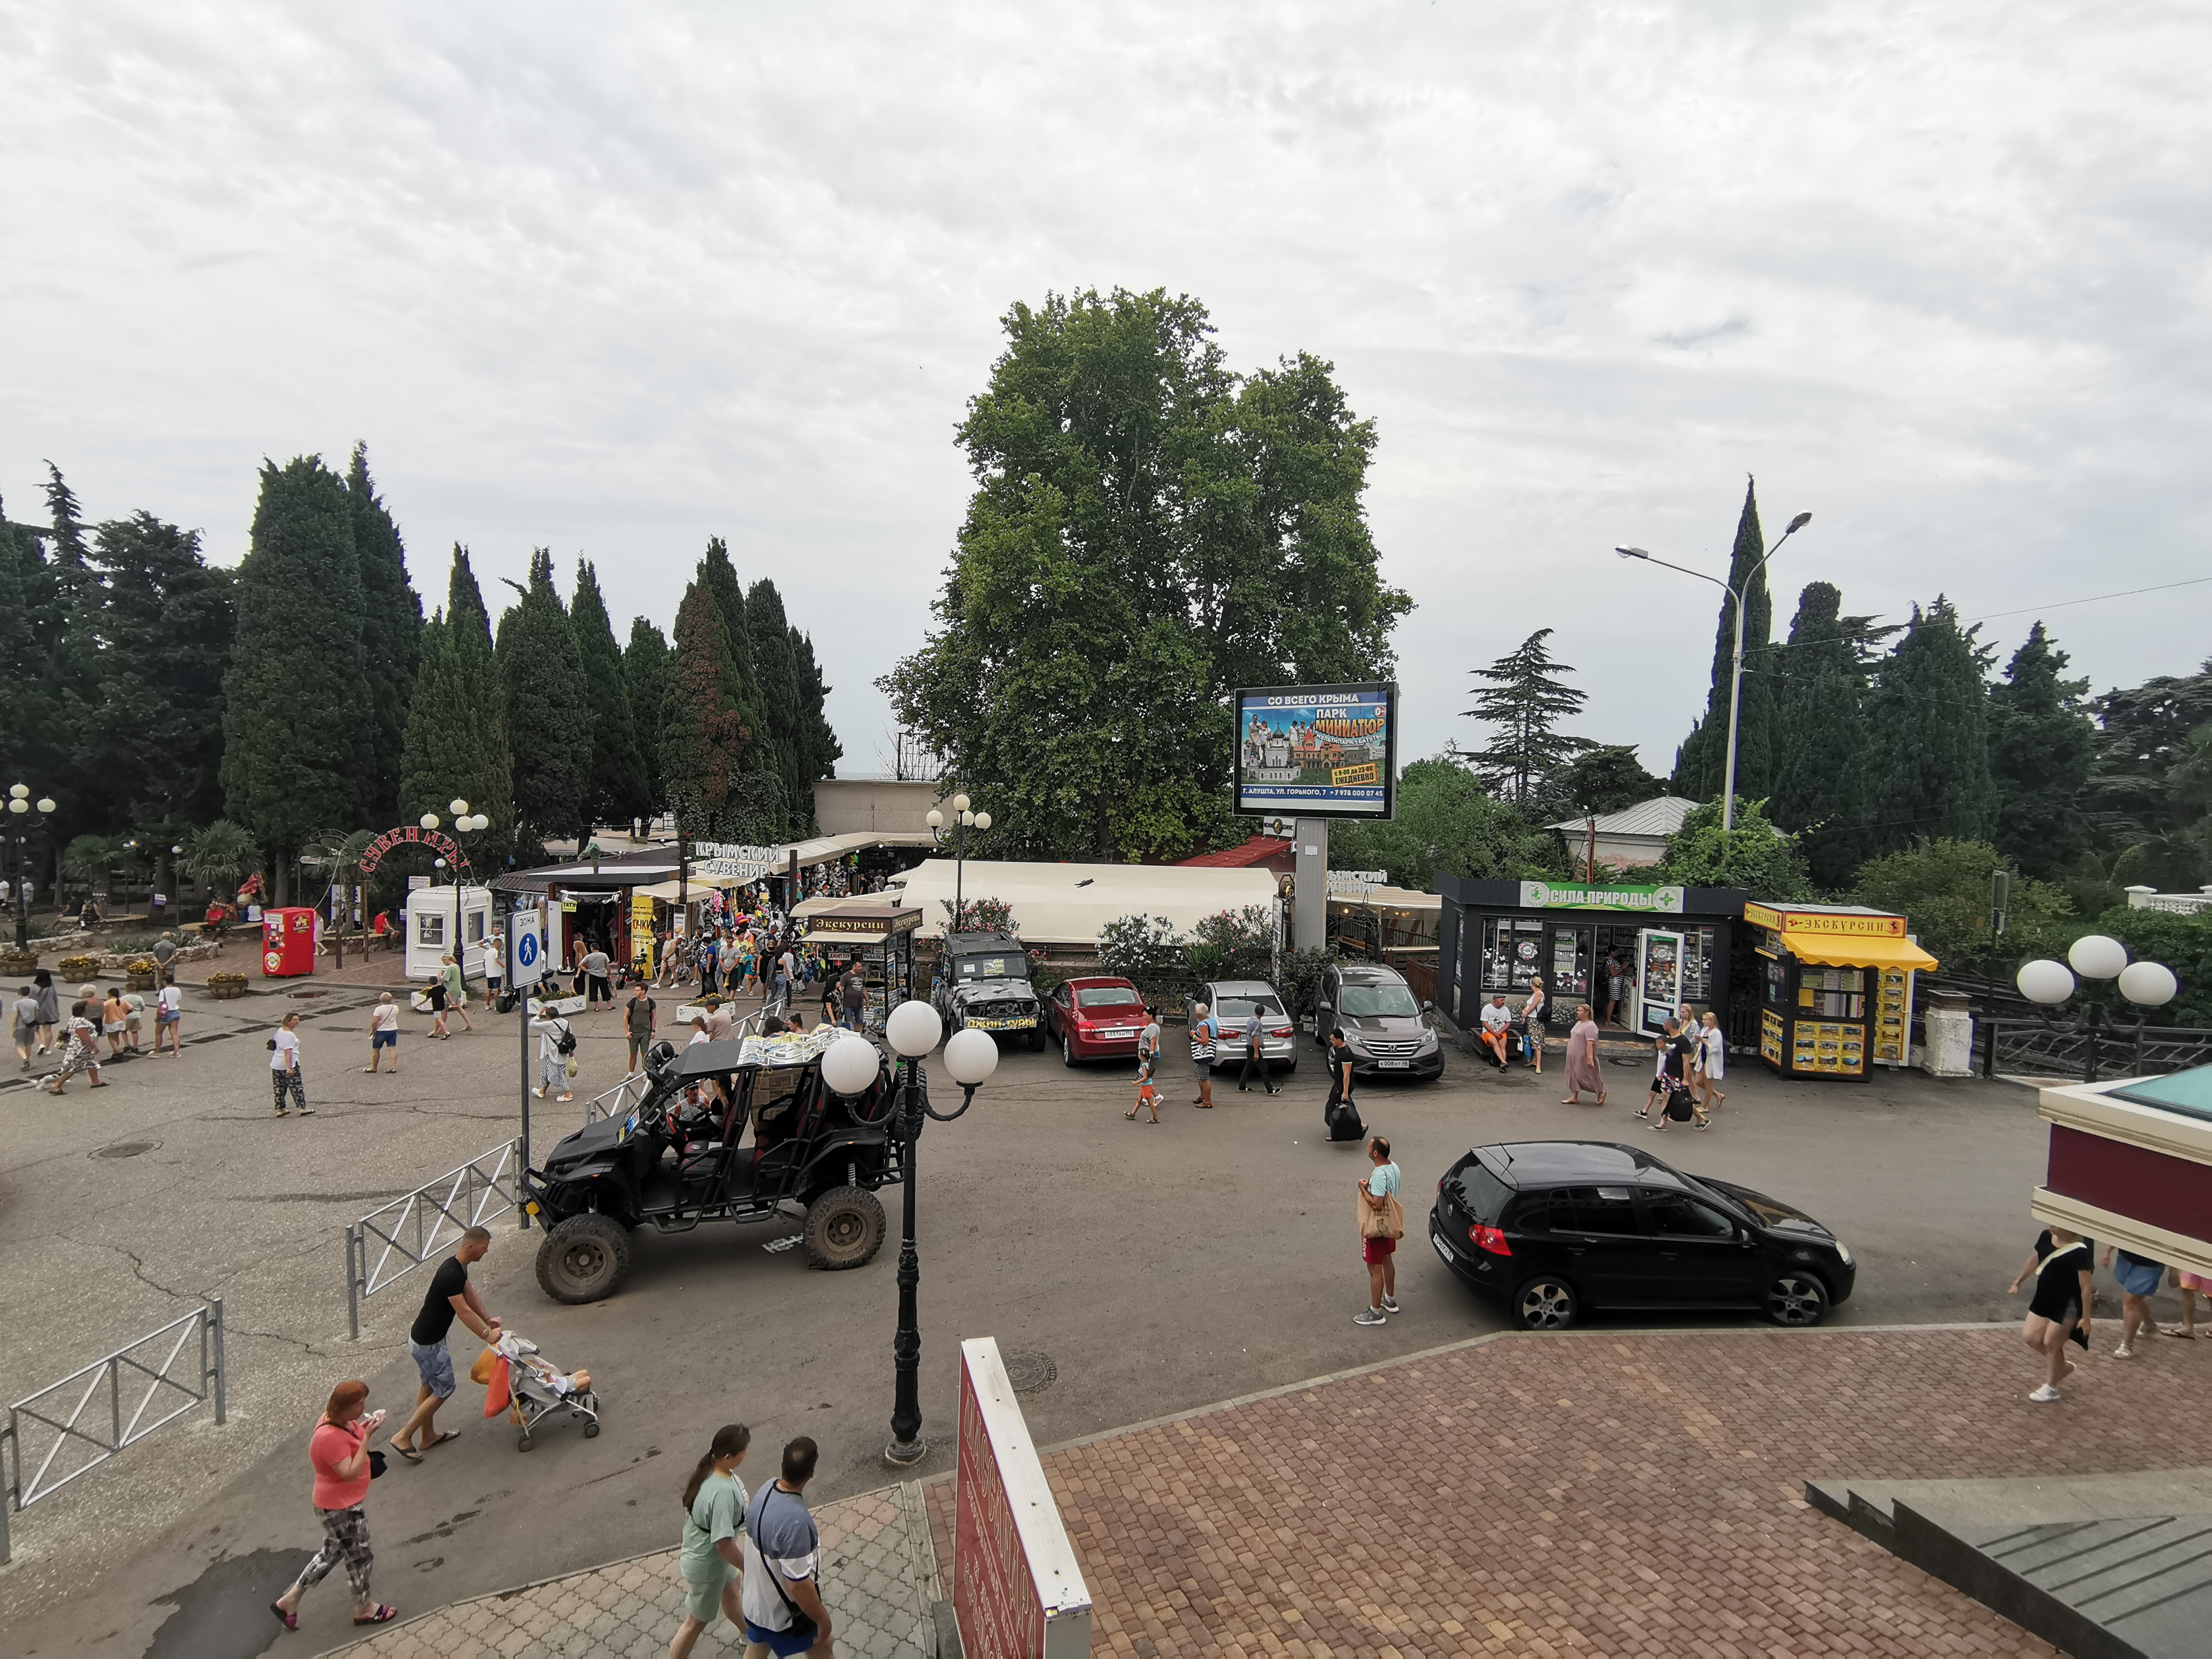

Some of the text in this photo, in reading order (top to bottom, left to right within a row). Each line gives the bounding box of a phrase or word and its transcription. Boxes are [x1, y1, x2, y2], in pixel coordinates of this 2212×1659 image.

[1268, 693, 1358, 705] СО ВСЕГО КРЫМА
[1316, 709, 1347, 719] ПАРК
[1316, 719, 1385, 738] МИНИАТЮР
[1316, 733, 1382, 745] МУЛЬТИПАРК БАТУТЫ
[1335, 772, 1374, 785] ЕЖЕДНЕВНО
[360, 826, 470, 872] СУВЕНИРЫ
[696, 842, 781, 863] КРЫМСКИЙ
[704, 860, 769, 879] СУВЕНИР
[1550, 890, 1585, 903] СИЛА
[1587, 891, 1653, 907] ПРИРОДЫ
[520, 916, 534, 927] ЗОНА
[817, 919, 884, 930] Экскурсии
[894, 914, 920, 928] Экскурсии
[1804, 919, 1884, 932] ЭКСКУРСИИ
[967, 1018, 1035, 1029] ДЖИП-ТУРЫ
[964, 1382, 1036, 1659] МАССАНДРА
[966, 1480, 999, 1606] ФИРМЕННЫЙ
